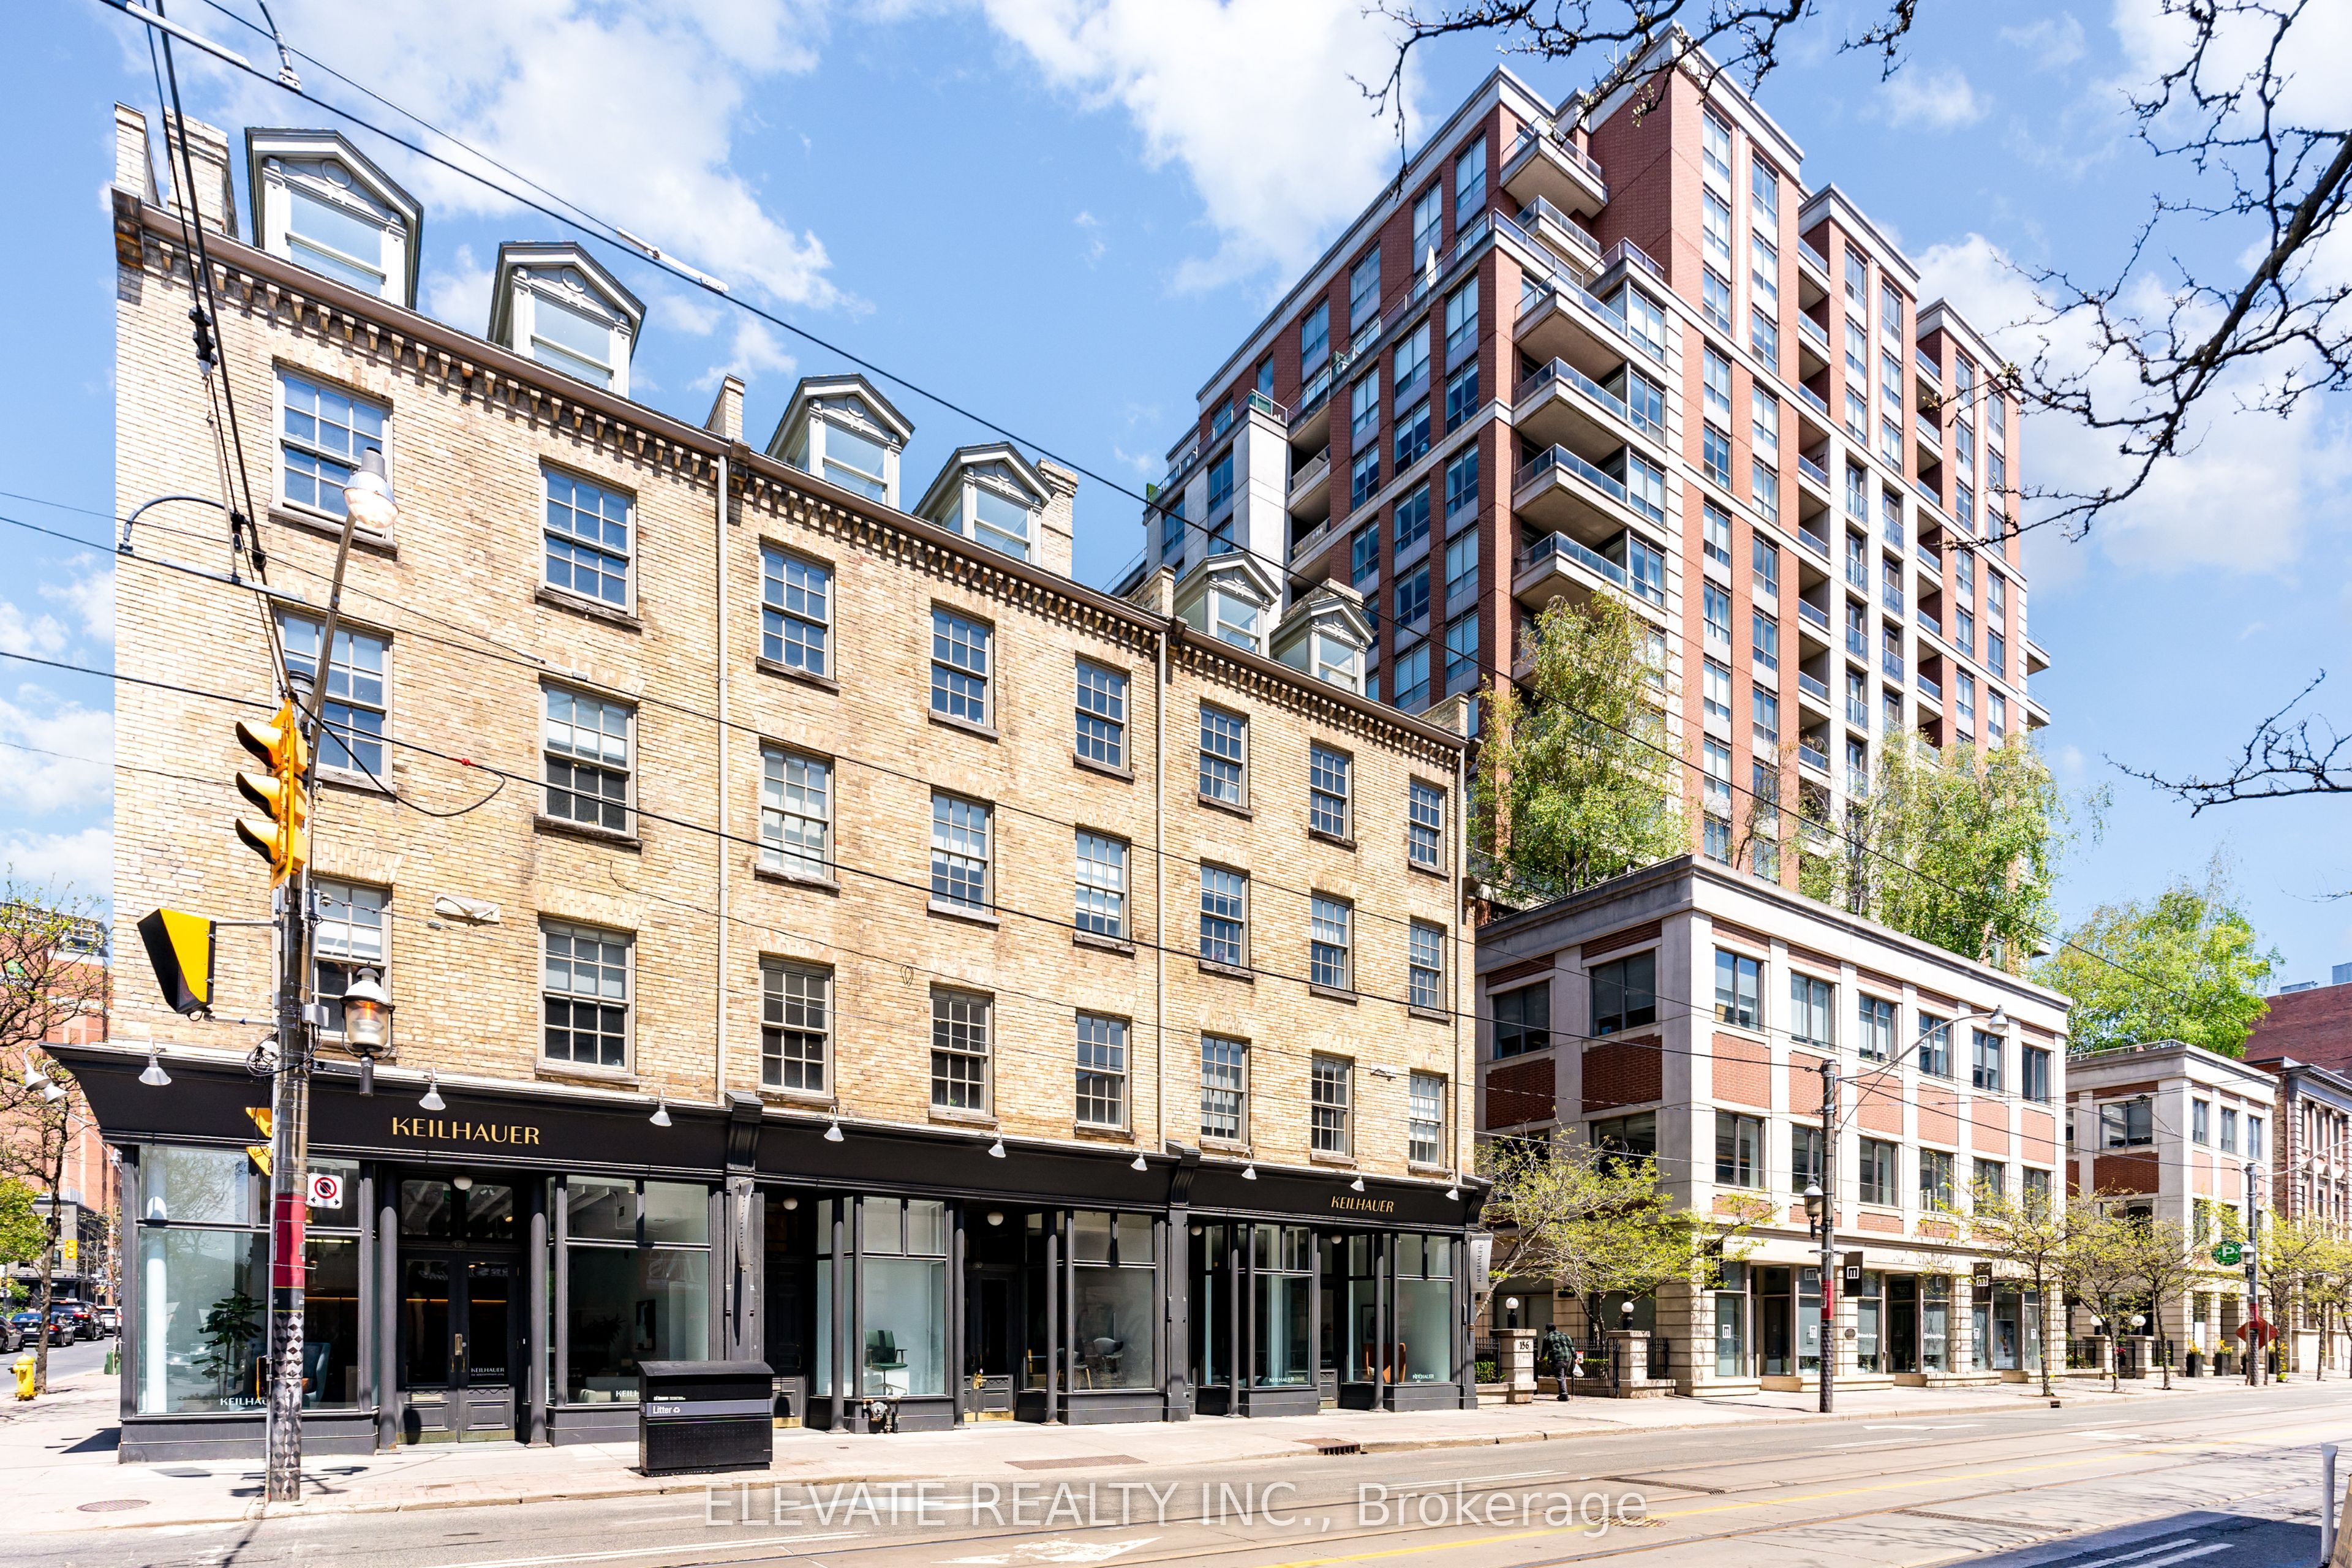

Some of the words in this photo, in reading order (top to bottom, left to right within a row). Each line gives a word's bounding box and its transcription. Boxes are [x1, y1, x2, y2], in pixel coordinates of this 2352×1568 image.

[392, 1117, 540, 1145] KEILHAUER
[1331, 1196, 1394, 1213] KEILHAUER
[2222, 1246, 2236, 1257] P
[1520, 1341, 1529, 1349] 156
[221, 1397, 267, 1406] KEILHAU
[653, 1405, 673, 1414] Litter
